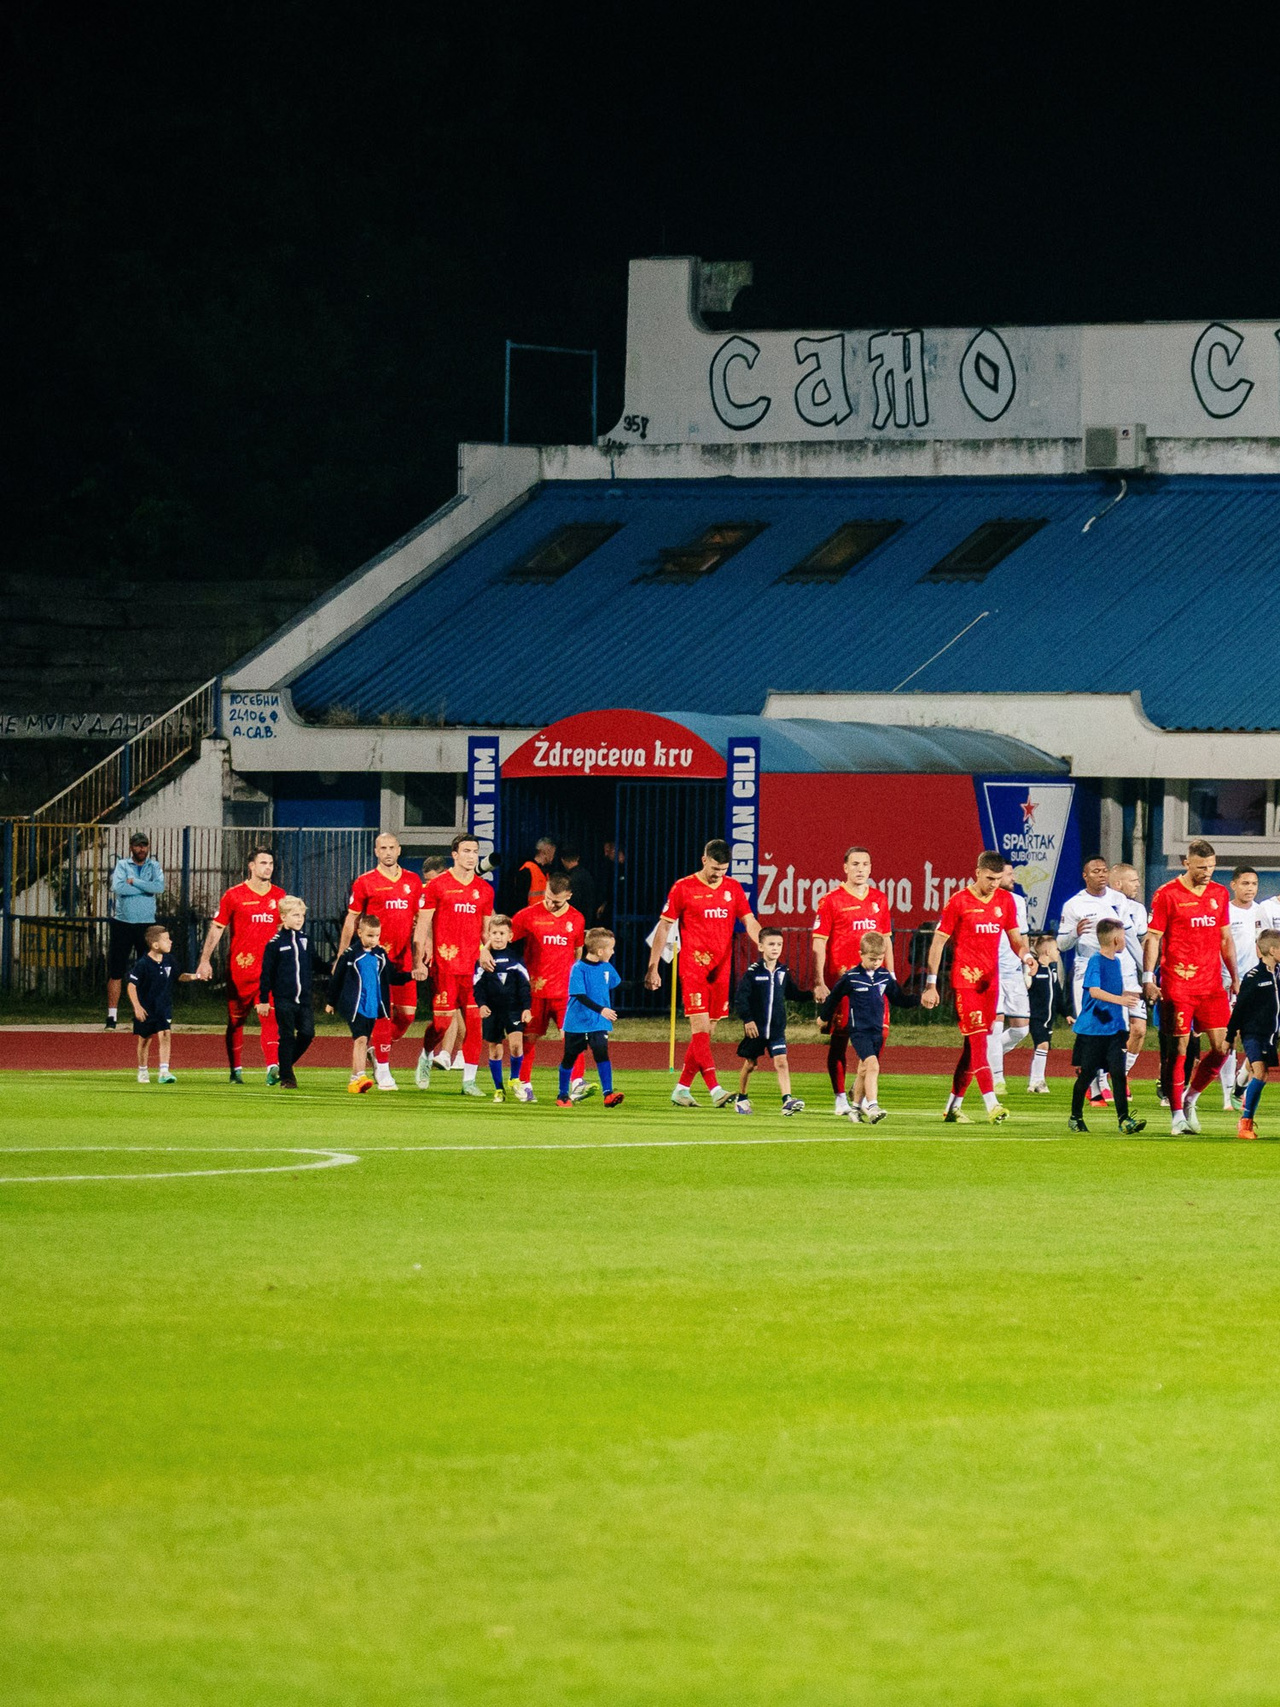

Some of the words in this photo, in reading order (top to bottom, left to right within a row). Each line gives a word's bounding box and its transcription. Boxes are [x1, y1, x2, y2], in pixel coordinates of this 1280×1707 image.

[533, 735, 646, 773] Ždrepčeva
[653, 739, 693, 767] krv
[474, 748, 495, 796] TIM
[733, 747, 756, 798] CILJ
[732, 806, 755, 884] JEDAN
[1003, 833, 1055, 850] SPARTAK
[1011, 851, 1047, 862] SUBOTICA
[385, 898, 409, 910] mts
[454, 902, 477, 914] mts
[251, 912, 274, 923] mts
[704, 906, 728, 918] mts
[853, 918, 877, 930] mts
[1190, 914, 1217, 928] mts
[975, 922, 1000, 934] mts
[543, 934, 568, 946] mts
